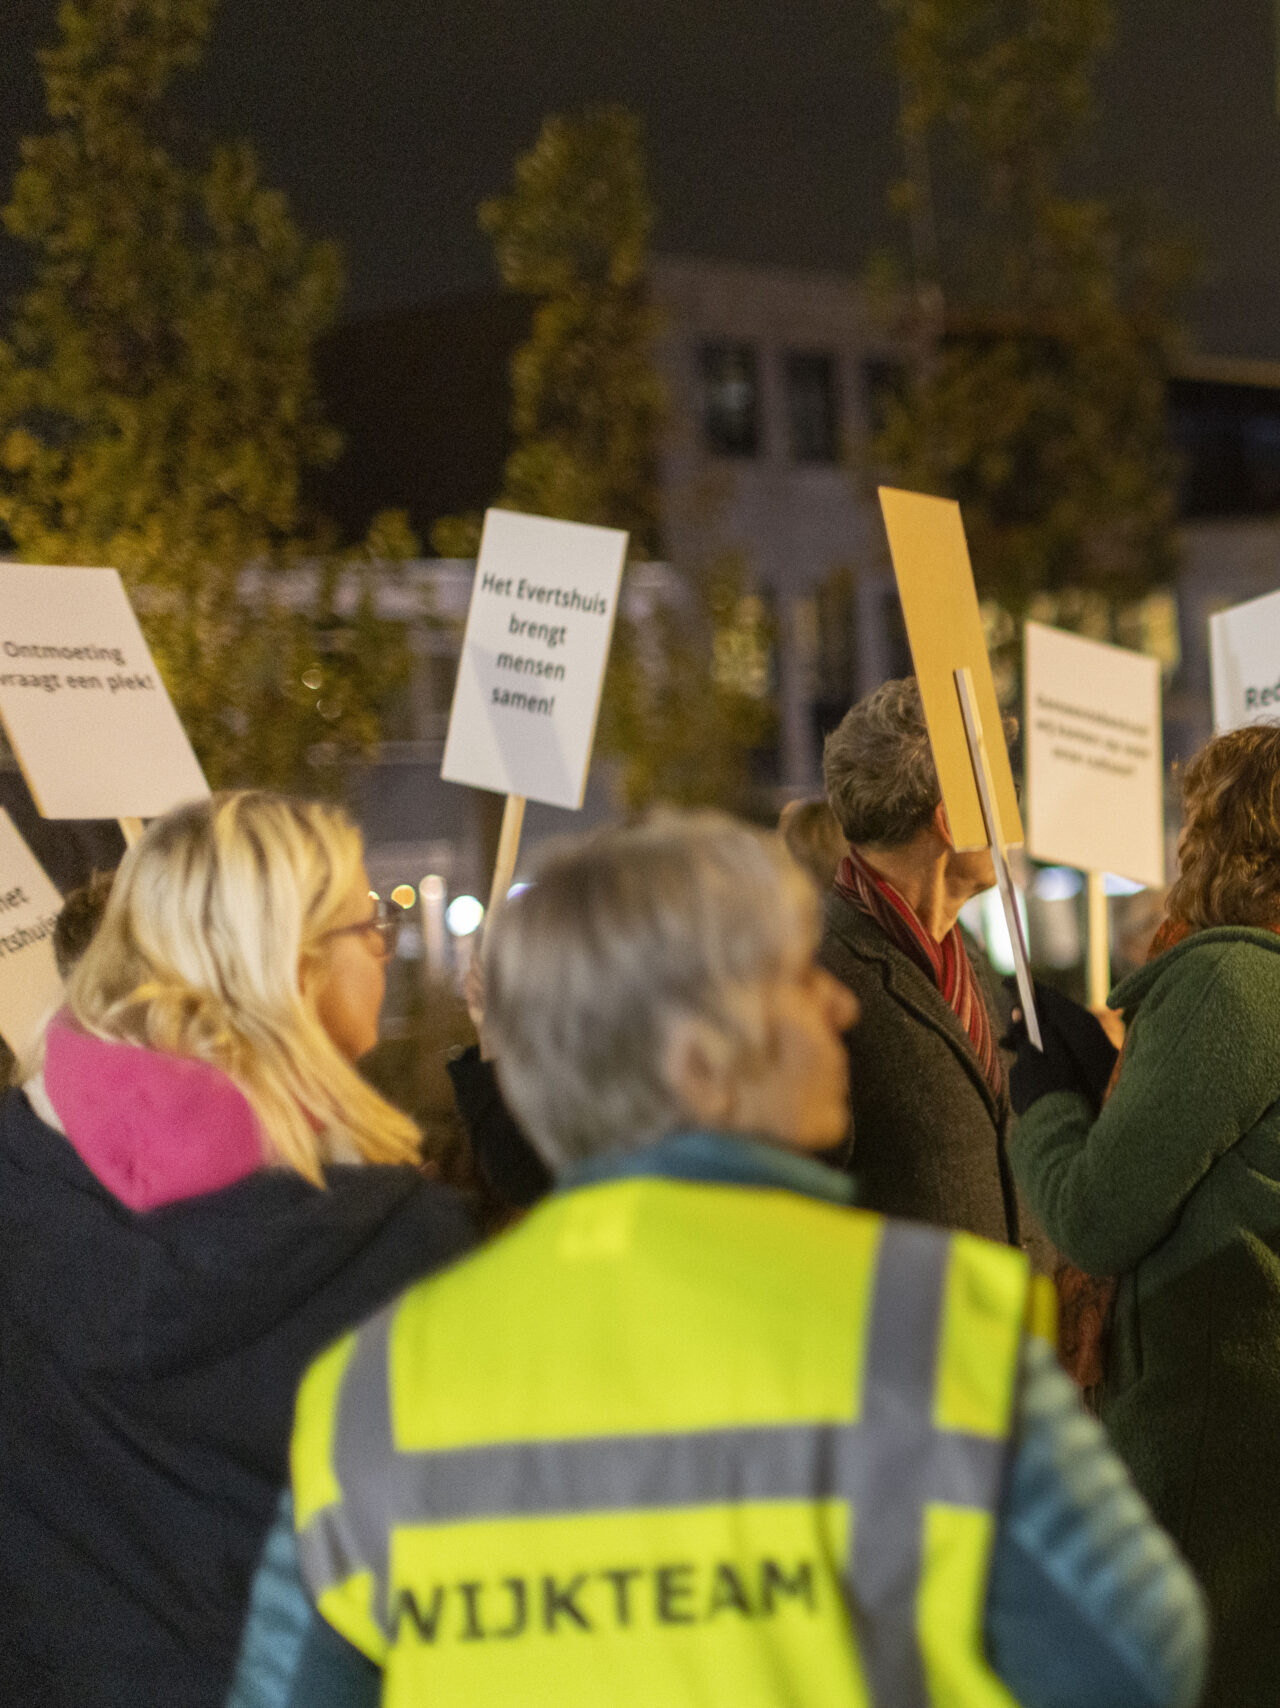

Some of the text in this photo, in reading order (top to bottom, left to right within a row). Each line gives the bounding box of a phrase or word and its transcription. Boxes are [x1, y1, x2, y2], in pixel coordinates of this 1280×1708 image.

[481, 572, 608, 615] Het Evertshuis
[508, 612, 567, 648] brengt
[3, 641, 126, 666] Ontmoeting
[497, 653, 566, 681] mensen
[66, 674, 104, 689] een
[107, 672, 154, 693] plek!
[491, 687, 556, 717] samen!
[388, 1556, 818, 1647] WIJKTEAM
